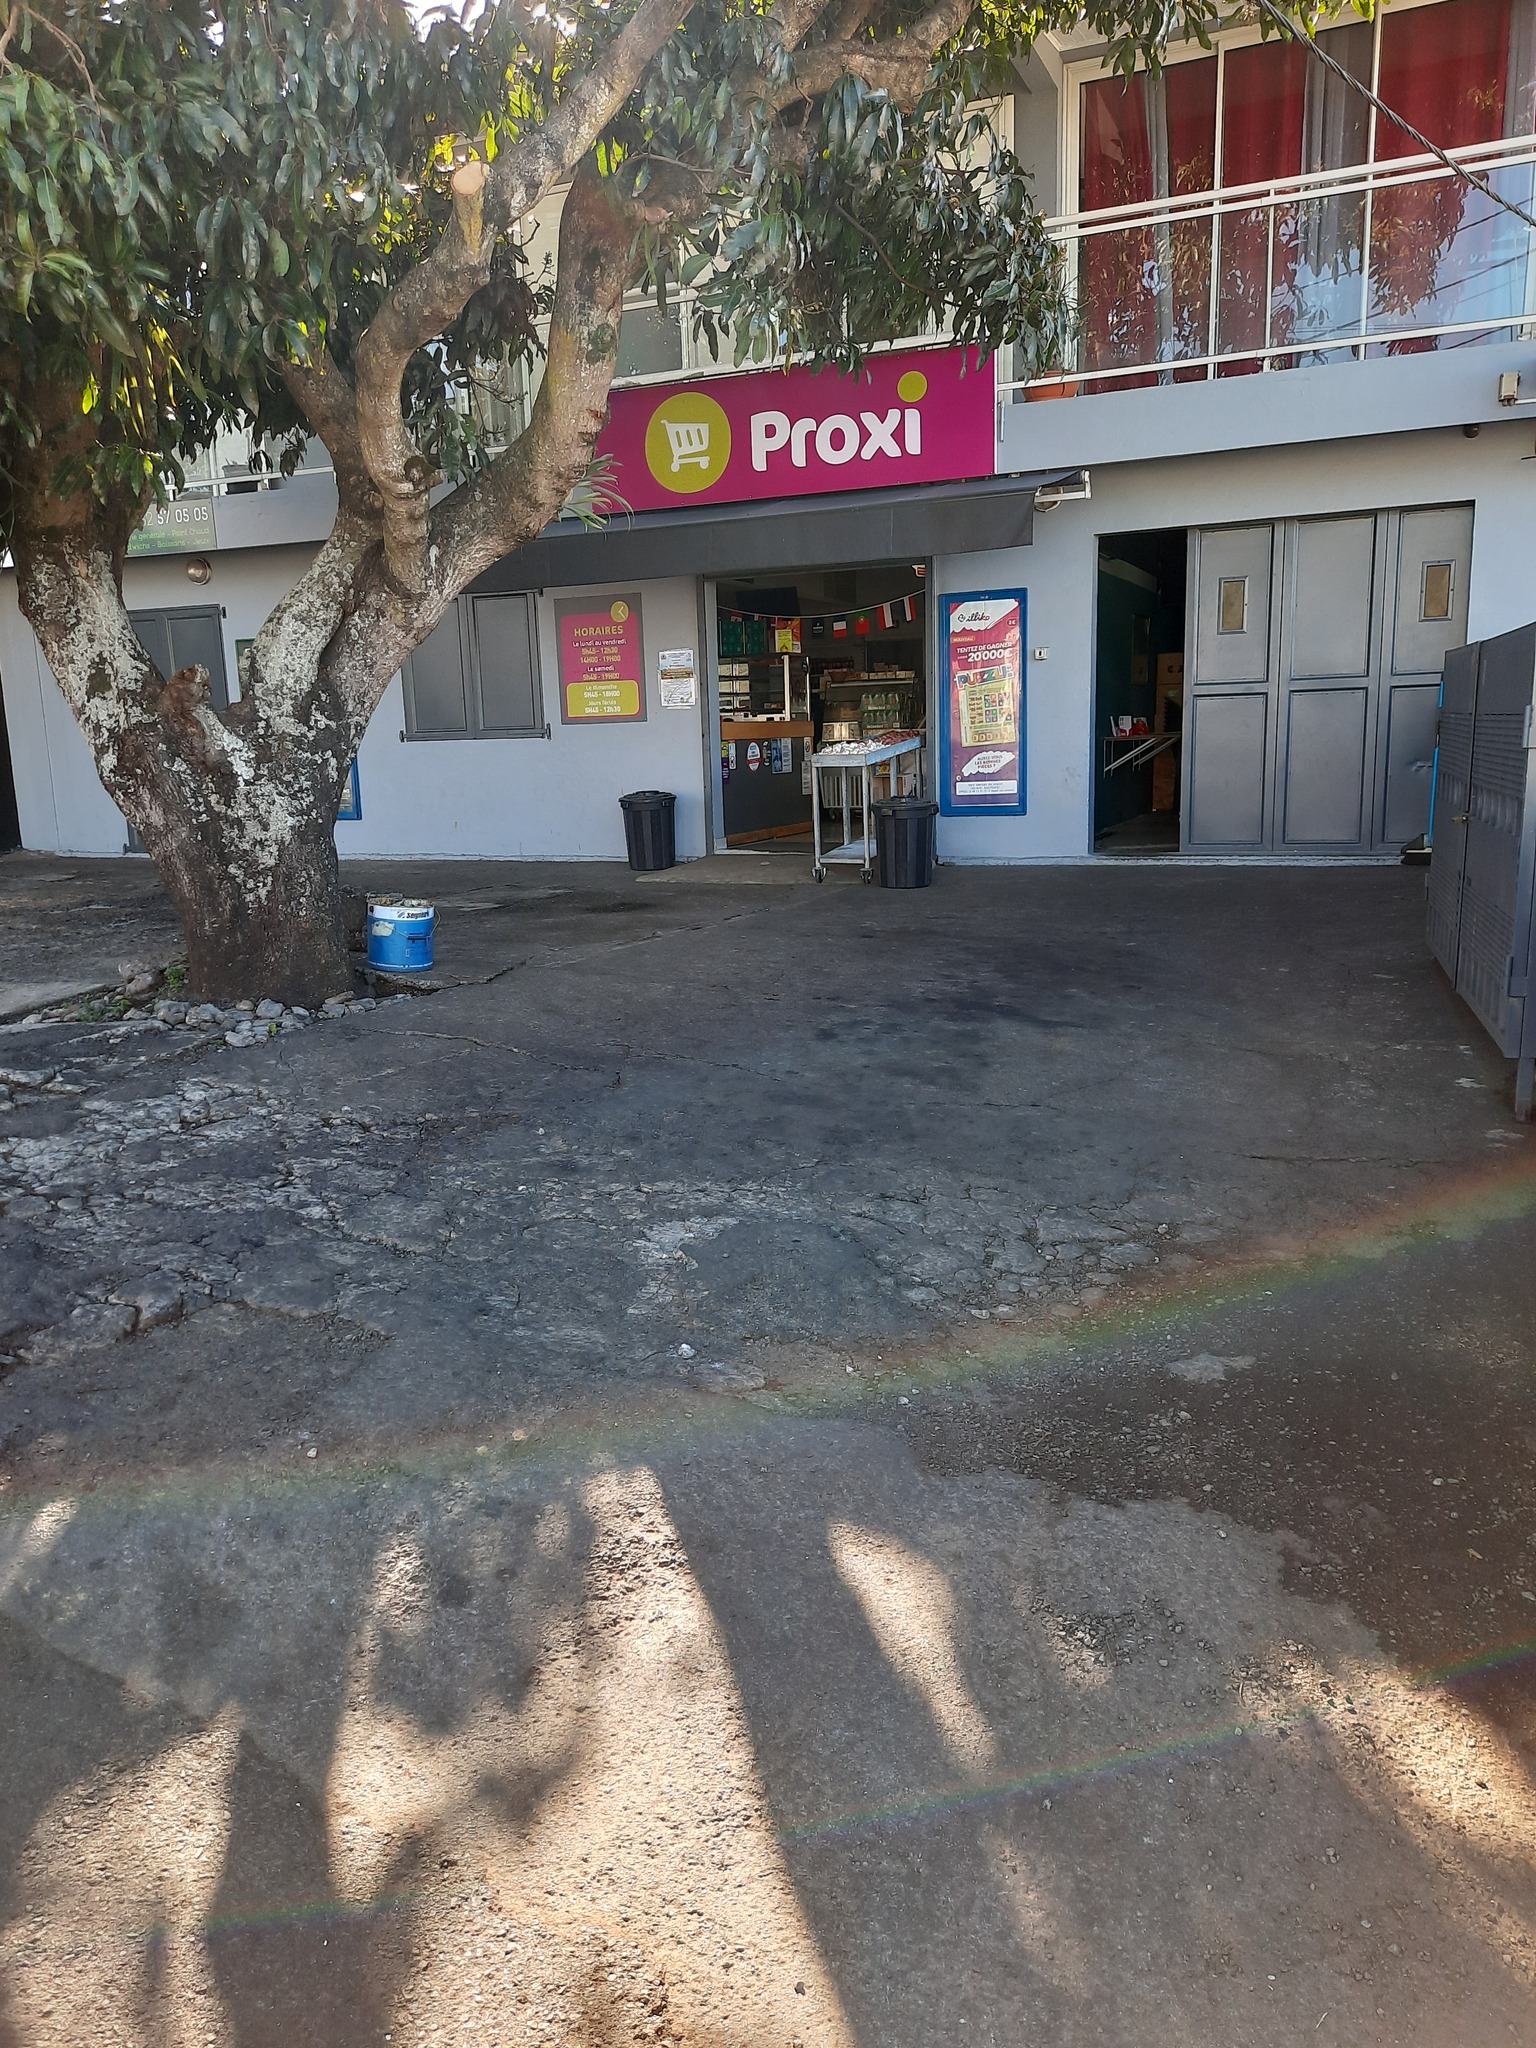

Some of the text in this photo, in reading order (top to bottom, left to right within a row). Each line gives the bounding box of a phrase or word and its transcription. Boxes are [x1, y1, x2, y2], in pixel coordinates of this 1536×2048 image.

[750, 371, 927, 472] Proxi
[175, 508, 189, 523] 05
[193, 506, 209, 521] 05
[574, 626, 624, 637] HORAIRES
[957, 646, 978, 654] TENTEZ
[986, 642, 1013, 650] GAGNER
